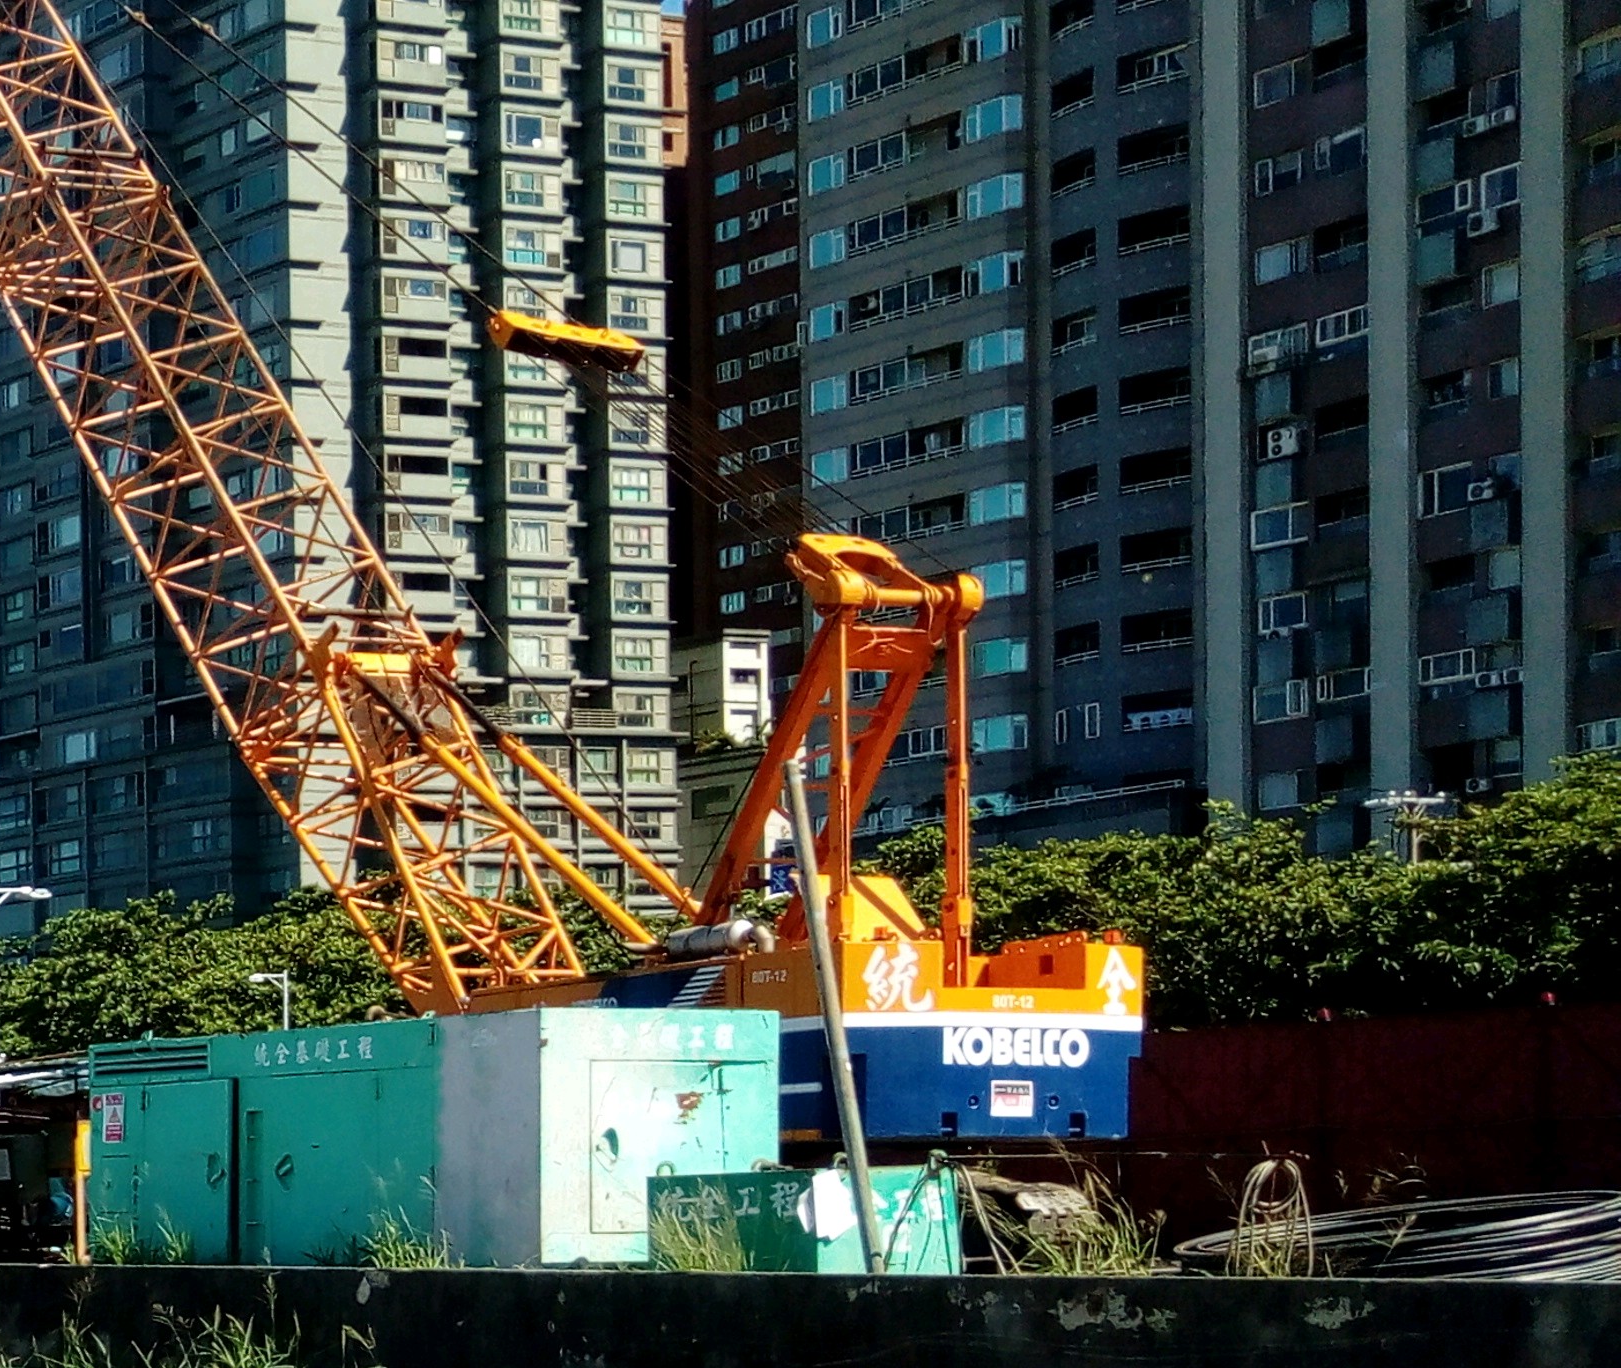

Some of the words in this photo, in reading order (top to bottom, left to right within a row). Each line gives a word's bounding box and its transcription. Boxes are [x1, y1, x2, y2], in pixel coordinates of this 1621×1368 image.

[862, 942, 934, 1012] 統
[1096, 946, 1137, 1016] 全
[942, 1026, 1090, 1068] KOBELCO
